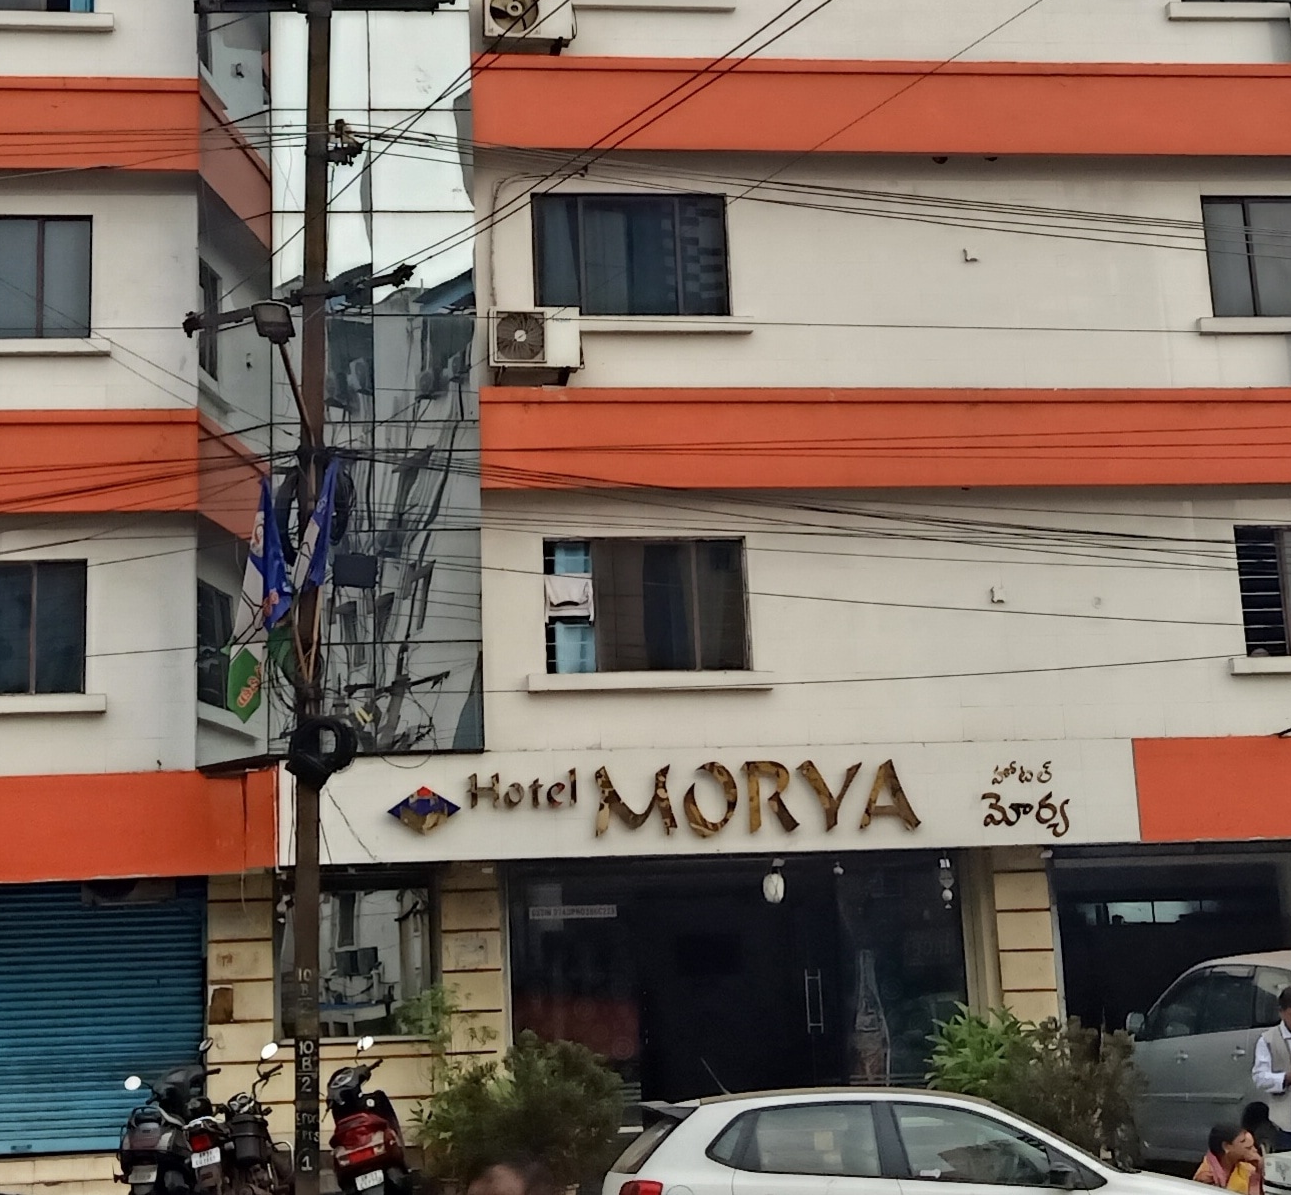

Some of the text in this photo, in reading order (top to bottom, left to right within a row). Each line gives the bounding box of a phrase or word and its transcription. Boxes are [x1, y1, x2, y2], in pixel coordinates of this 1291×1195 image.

[466, 758, 922, 838] Hotel MORYA
[981, 790, 1070, 838] మోర్య
[298, 968, 312, 981] 10
[299, 1040, 314, 1055] 10
[302, 1056, 312, 1072] B
[301, 1076, 312, 1092] 2
